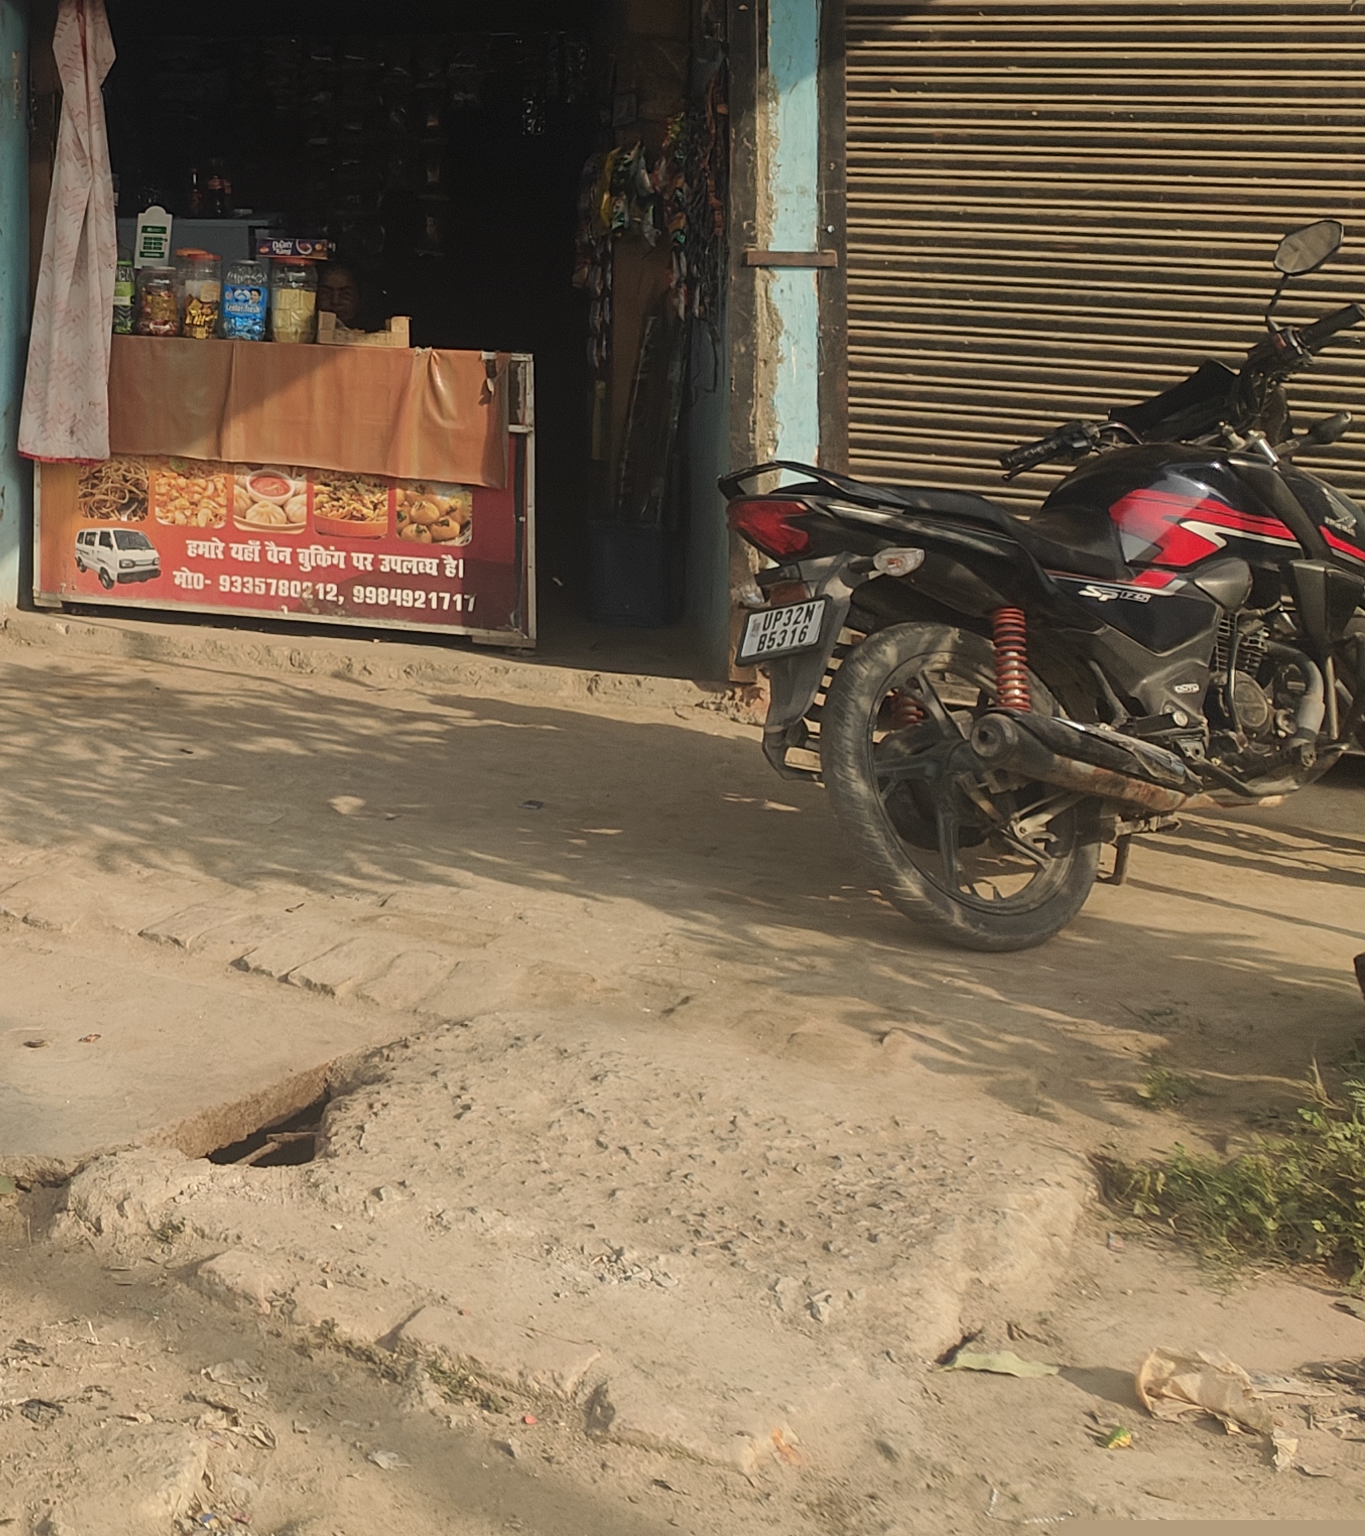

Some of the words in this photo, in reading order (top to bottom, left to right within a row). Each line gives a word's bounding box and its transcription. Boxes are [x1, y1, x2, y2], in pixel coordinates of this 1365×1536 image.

[185, 536, 226, 560] हमारे
[229, 539, 262, 563] यहाँ
[264, 540, 293, 565] वैन
[296, 545, 347, 572] बुकिंग
[351, 552, 375, 571] पर
[378, 554, 440, 576] उपलब्ध
[352, 585, 477, 612] 9984921717
[762, 603, 816, 632] UP32N
[756, 624, 810, 652] B5316
